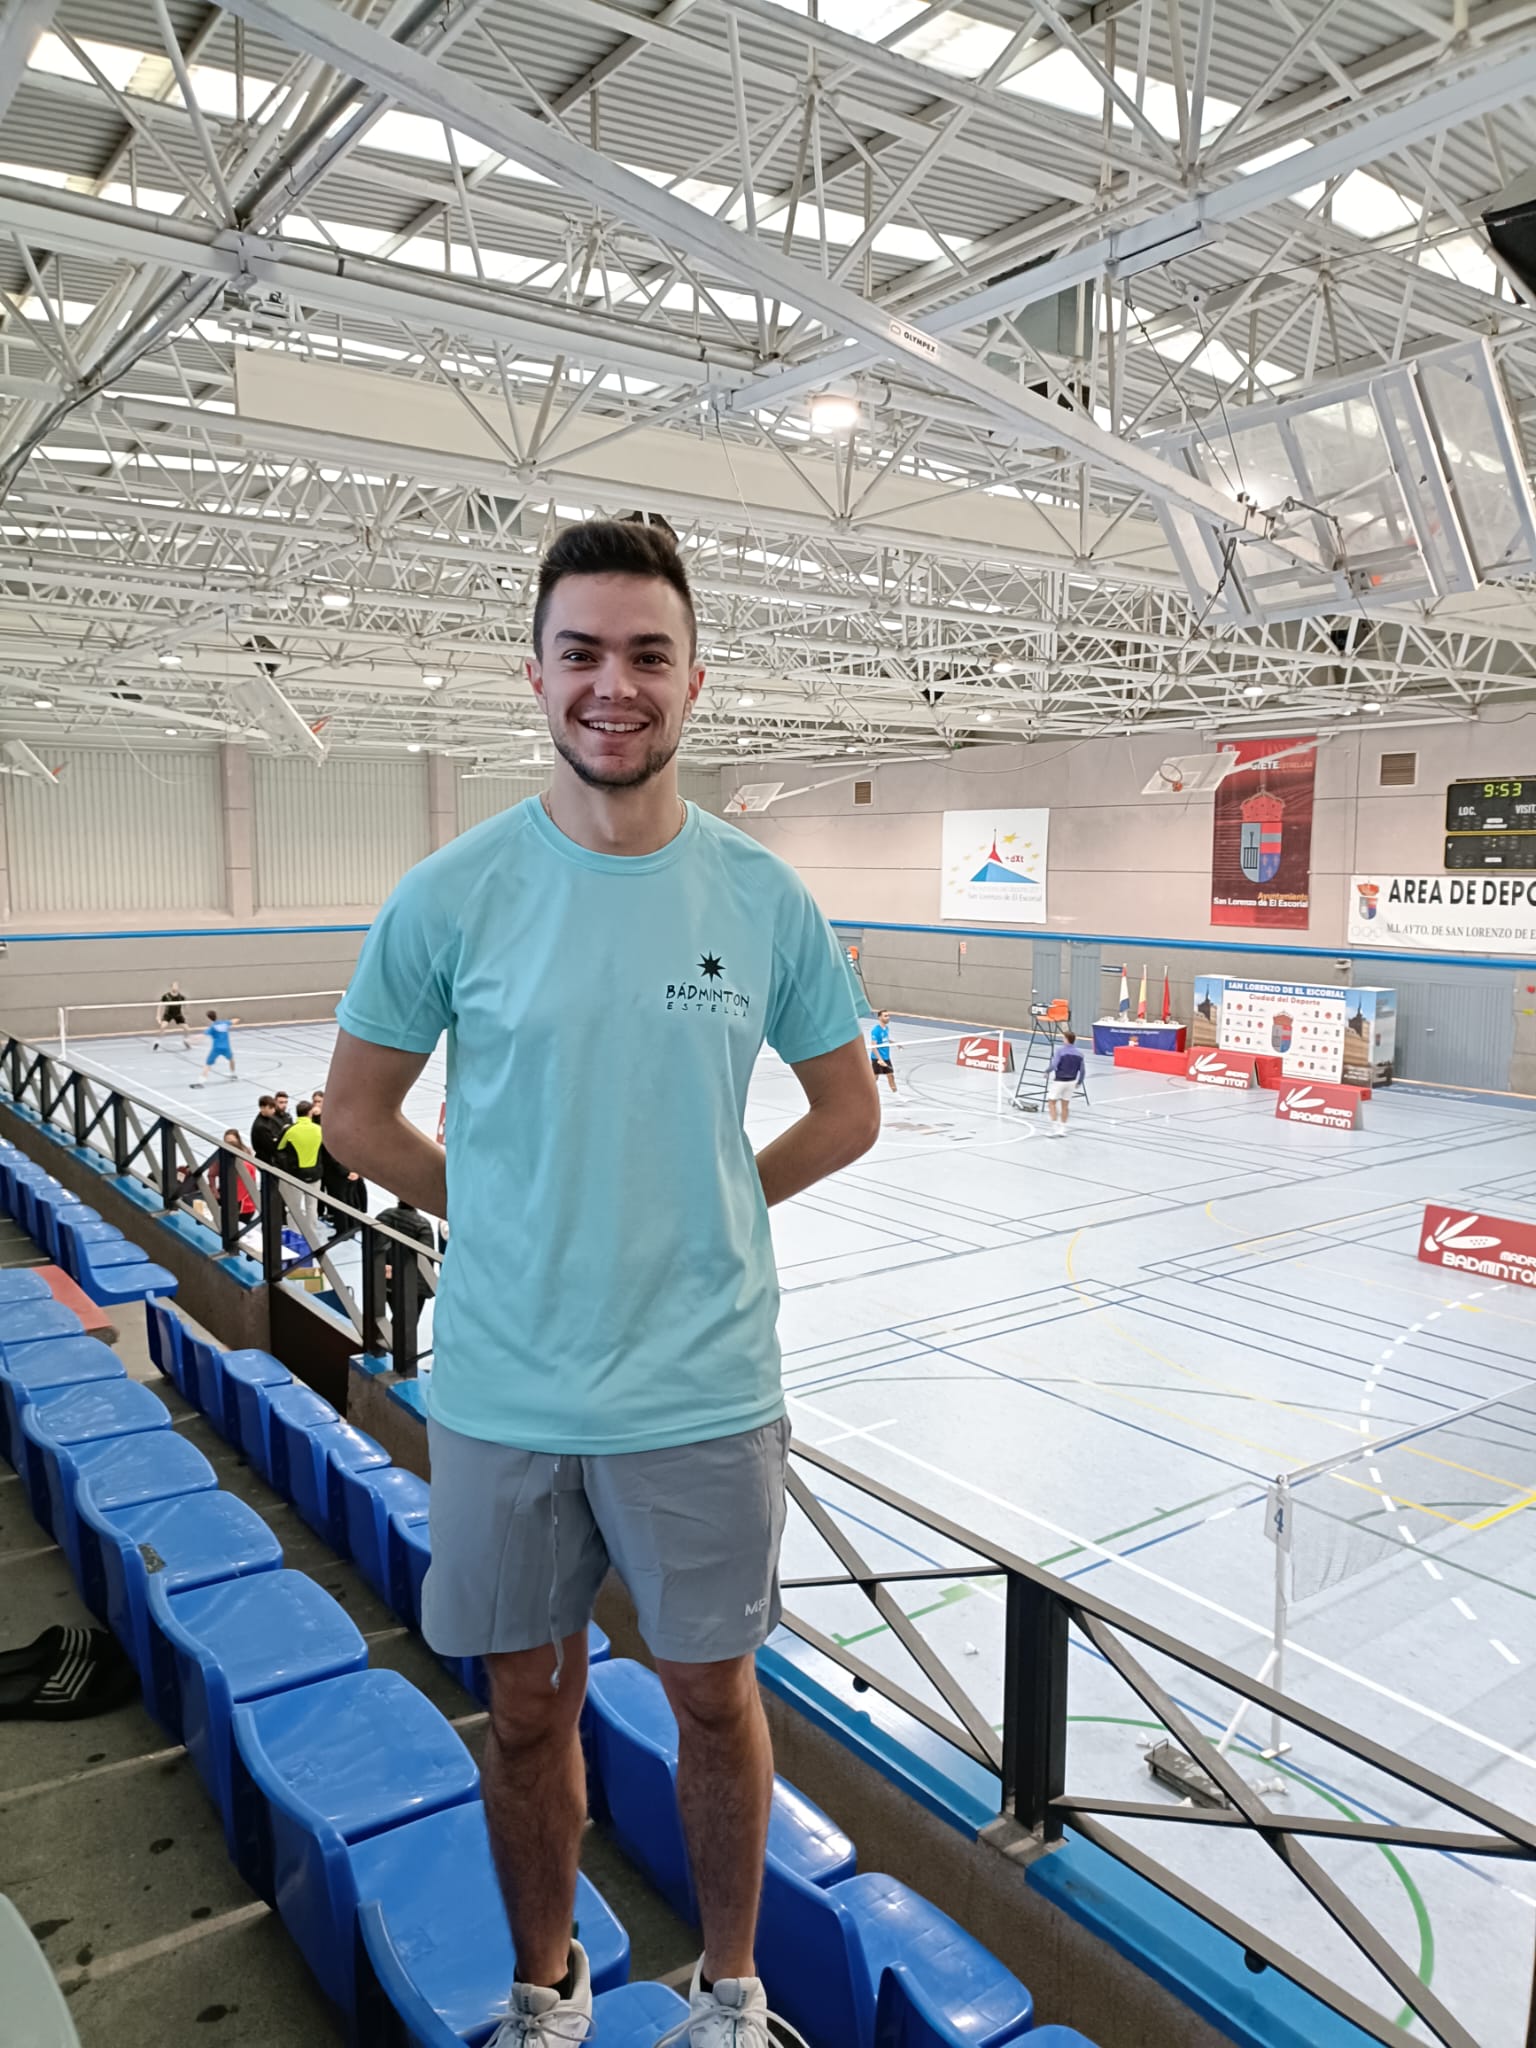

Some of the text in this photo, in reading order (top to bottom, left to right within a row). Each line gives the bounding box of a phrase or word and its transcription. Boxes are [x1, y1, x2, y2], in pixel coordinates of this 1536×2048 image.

[904, 331, 935, 352] OLYMPEX
[1484, 783, 1522, 797] 9:53
[1458, 806, 1477, 816] LOC.
[1388, 879, 1443, 904] AREA
[1450, 880, 1477, 905] DE
[1213, 897, 1227, 905] San
[1228, 898, 1257, 906] Lorenzo
[1278, 900, 1309, 908] Escorial
[1431, 925, 1445, 936] DE
[1446, 925, 1465, 937] SAN
[1466, 926, 1512, 939] LORENZO
[1514, 928, 1529, 940] DE
[666, 982, 749, 1008] BÁDMINTON
[1229, 982, 1345, 998] SAN LORENZO DE EL ESCORIAL
[1249, 993, 1275, 1002] Ciudad
[1290, 997, 1321, 1006] Deporte
[667, 1002, 746, 1017] ESTELLA
[1289, 1110, 1352, 1129] BADMINTON
[1442, 1251, 1536, 1286] BADMINTO
